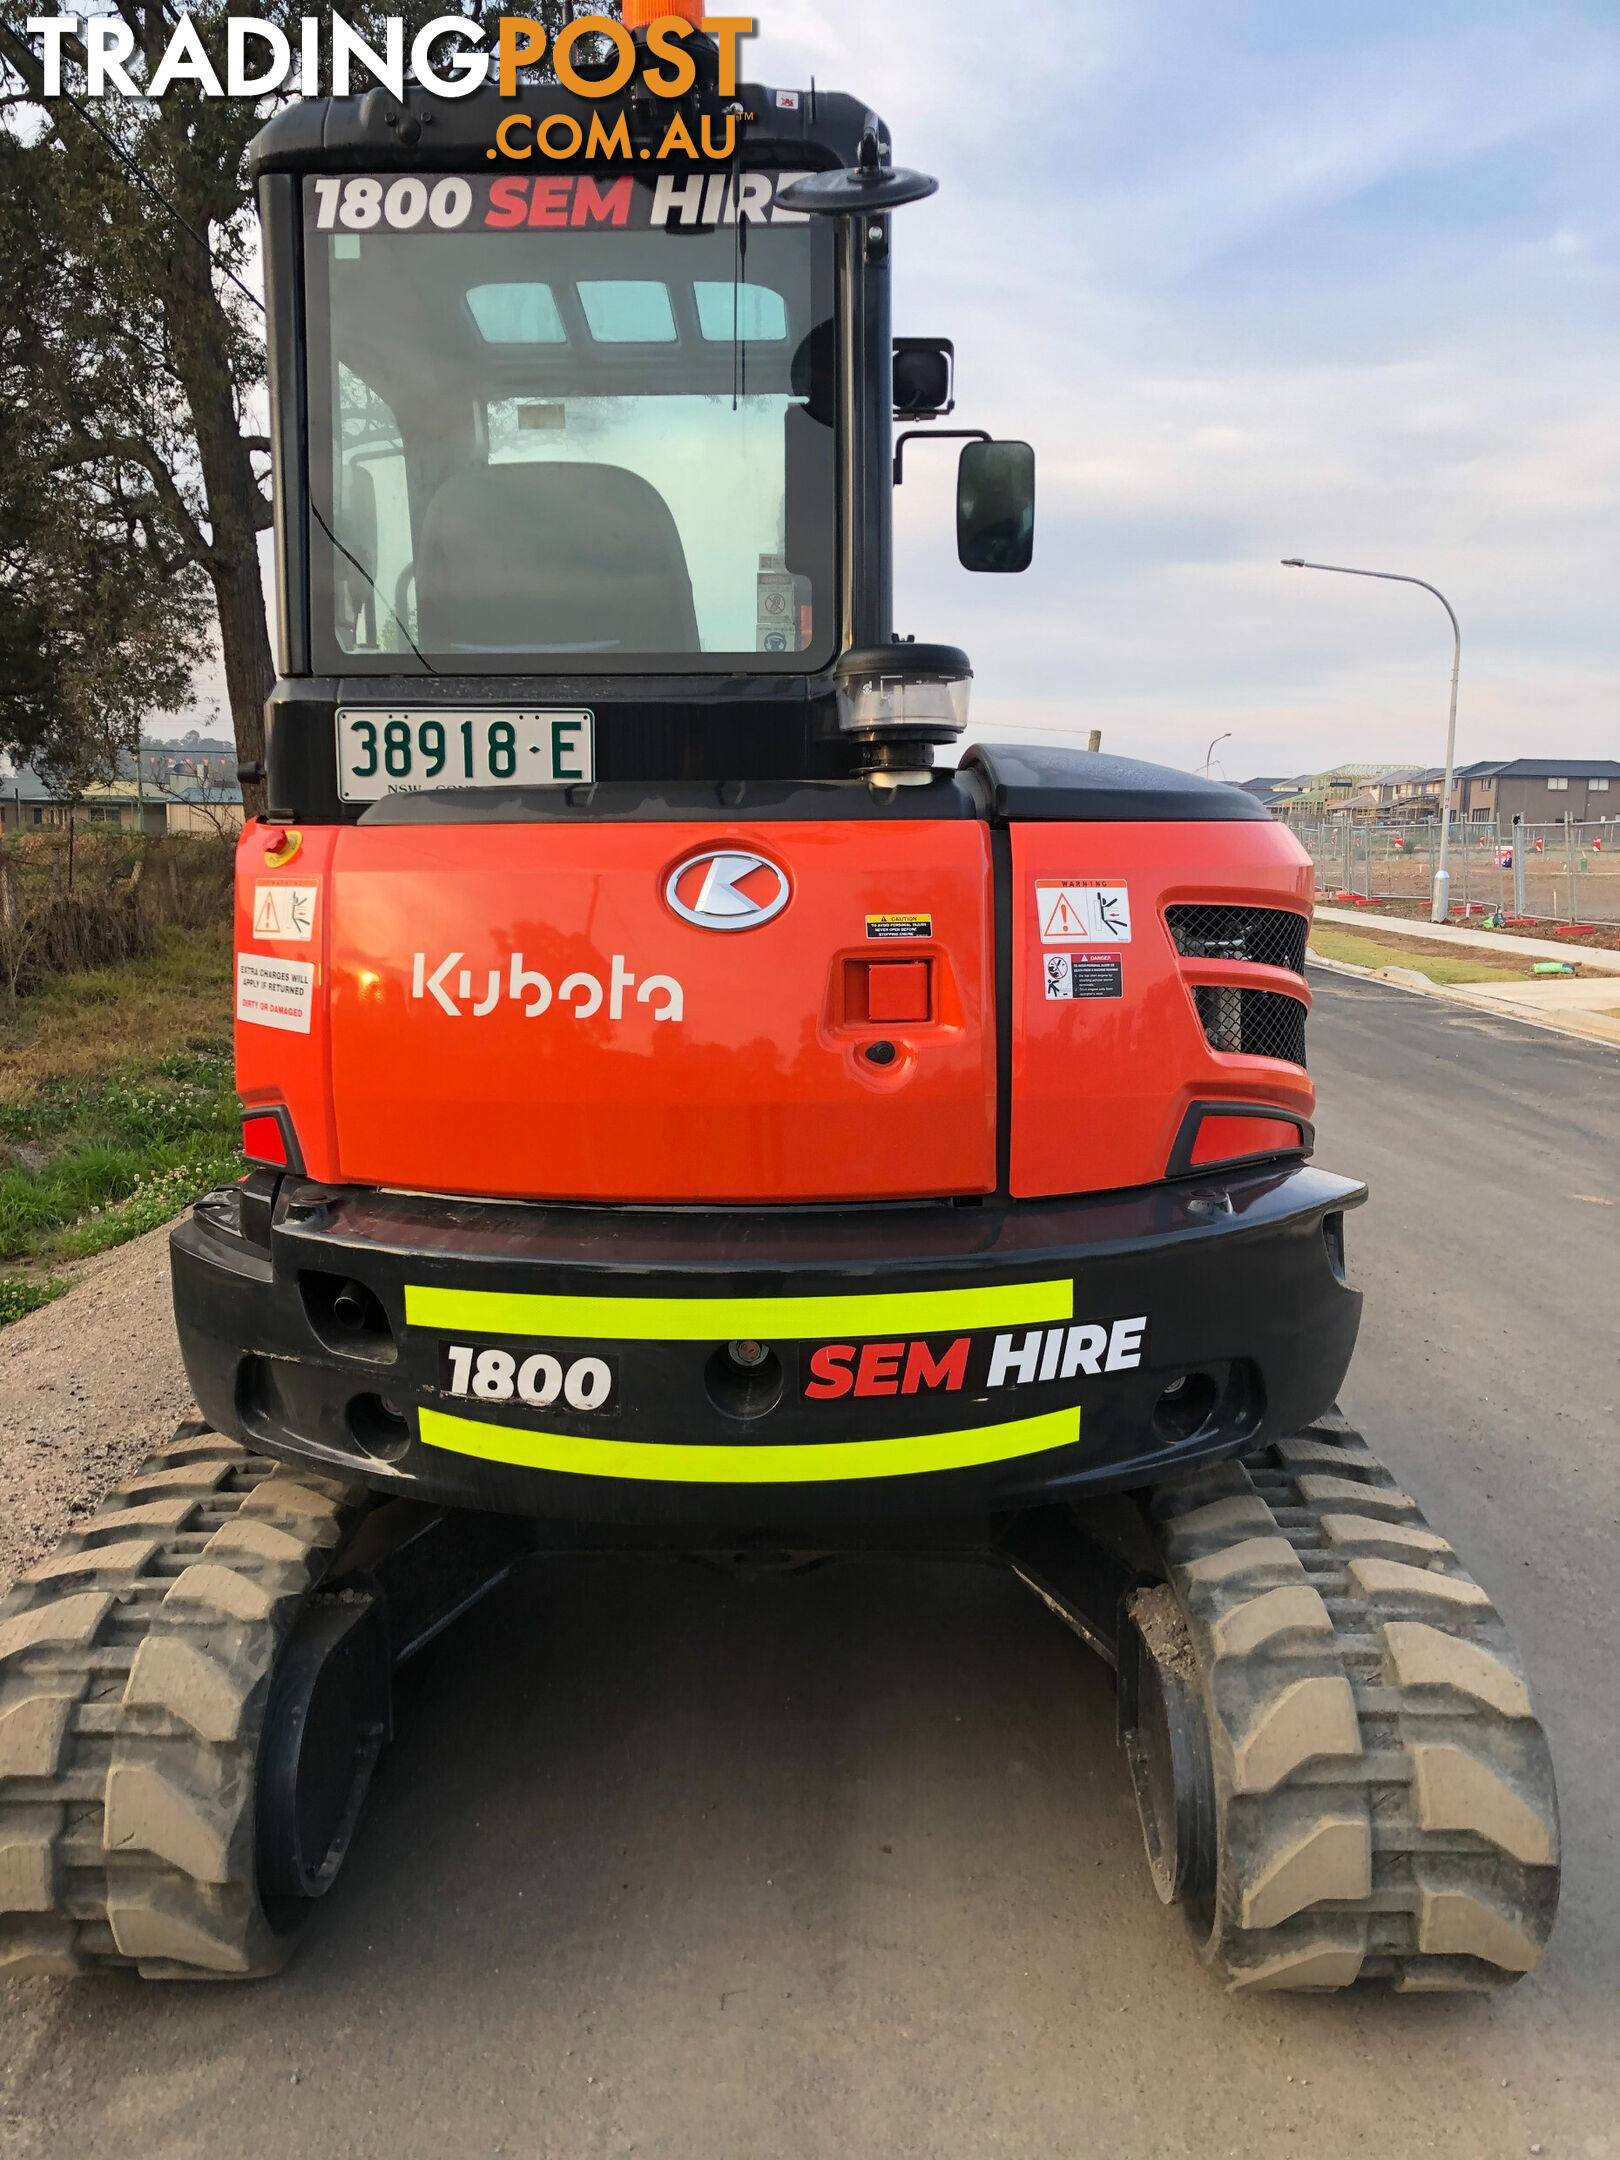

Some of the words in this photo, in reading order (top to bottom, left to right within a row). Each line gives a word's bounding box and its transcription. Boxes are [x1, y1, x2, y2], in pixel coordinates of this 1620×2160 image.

[314, 177, 472, 230] 1800
[484, 176, 634, 228] SEM
[1061, 880, 1108, 888] WARNING
[240, 965, 258, 975] EXTRA
[260, 969, 289, 981] CHARGES
[291, 974, 308, 984] WILL
[243, 978, 259, 988] APPLY
[260, 981, 267, 989] IF
[268, 983, 304, 996] RETURNED
[412, 952, 684, 1022] Kubota
[242, 999, 258, 1009] DIRTY
[260, 1002, 269, 1012] OR
[270, 1004, 303, 1017] DAMAGED
[448, 1345, 612, 1411] 1800
[804, 1337, 972, 1400] SEM
[986, 1315, 1148, 1388] HIRE
